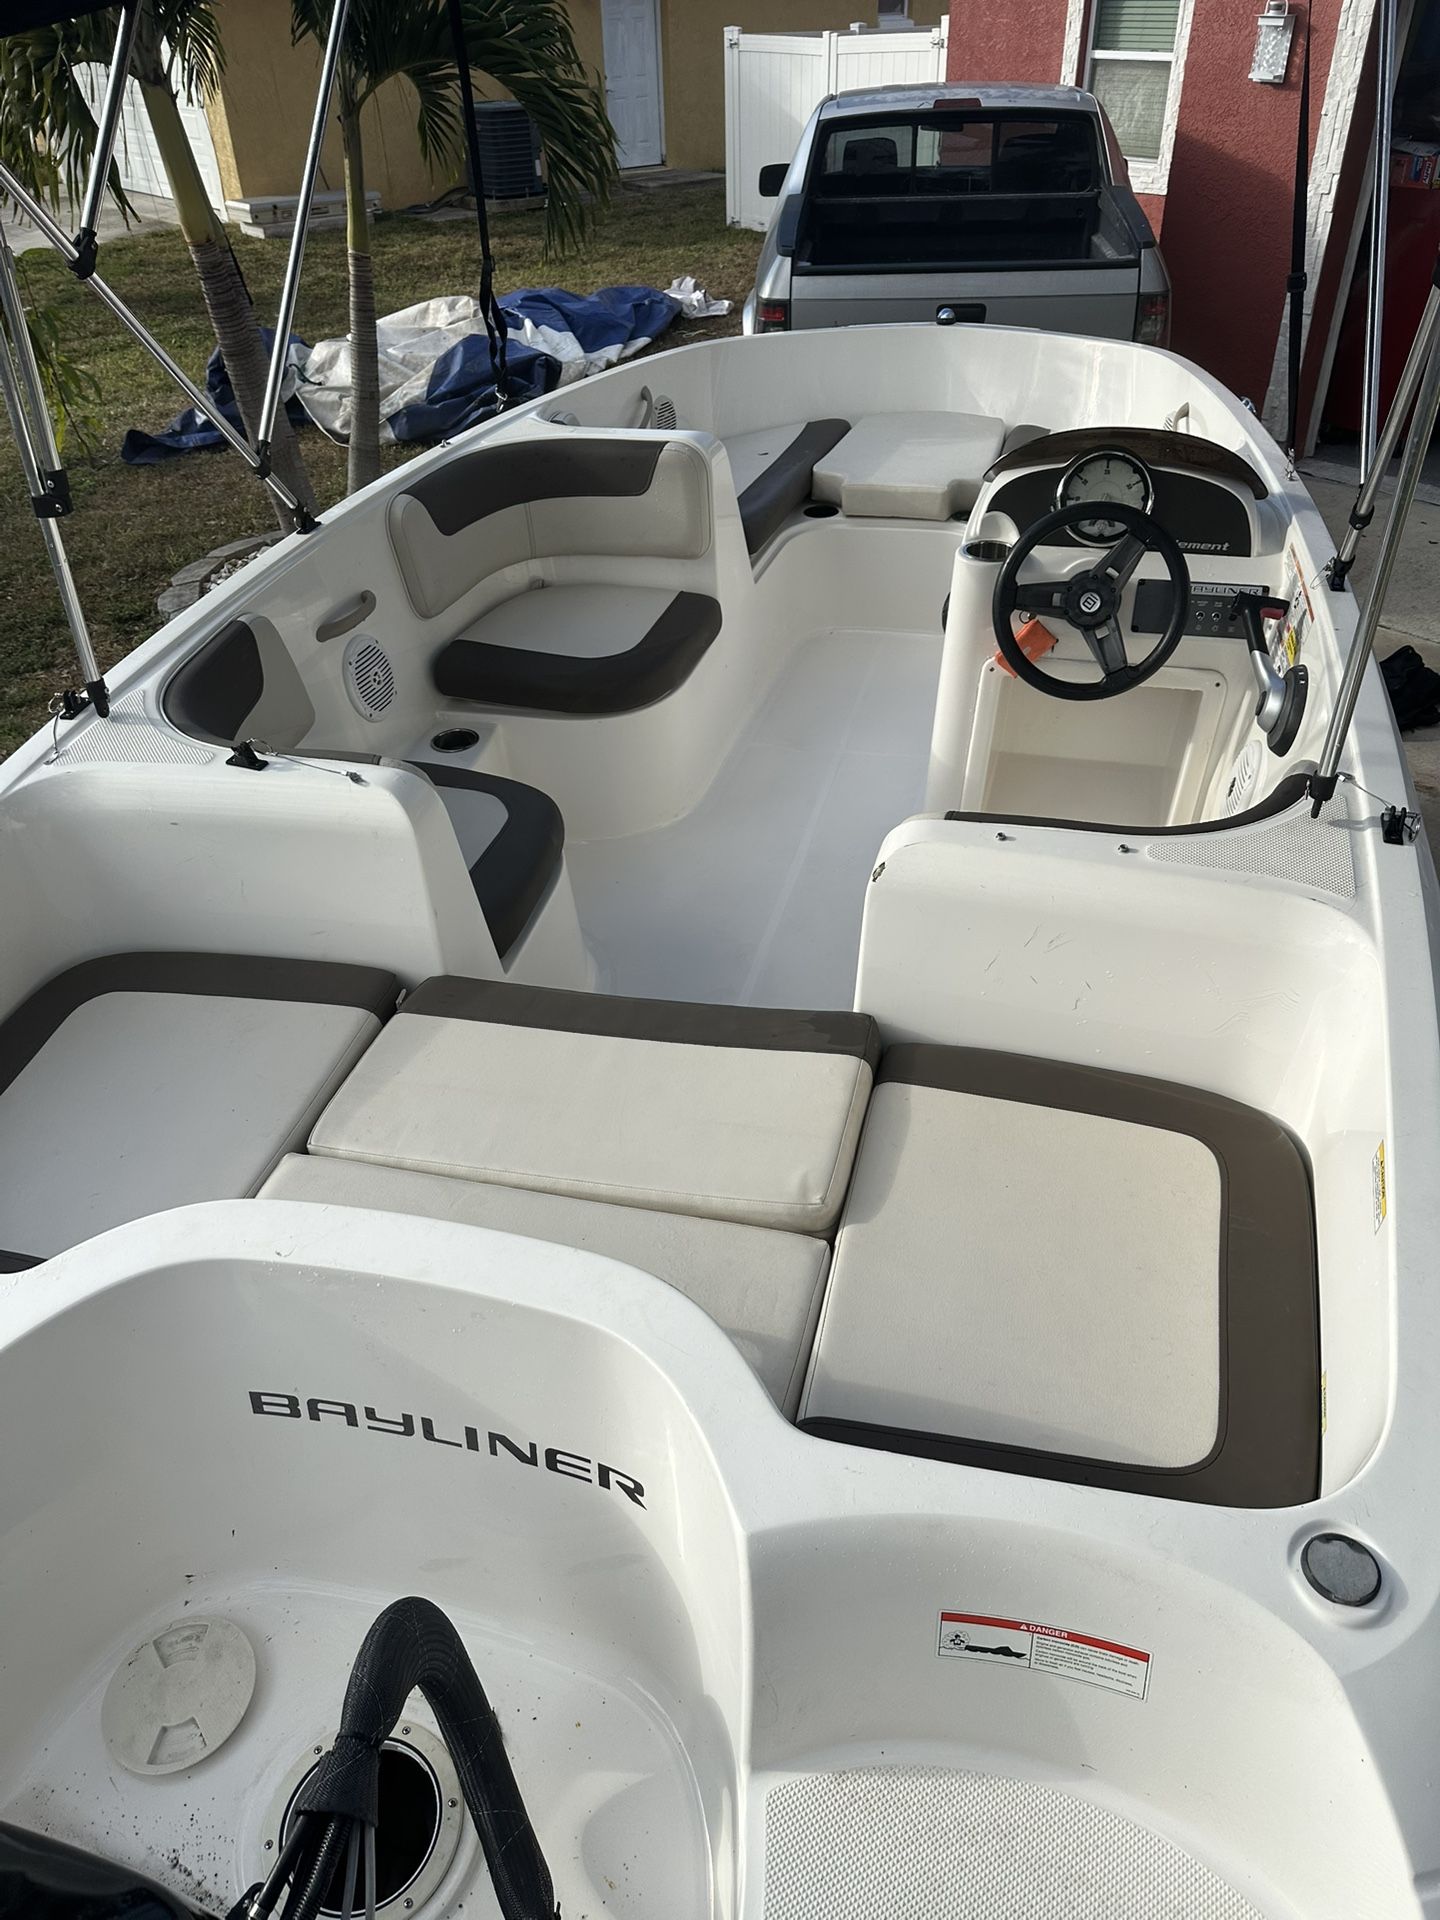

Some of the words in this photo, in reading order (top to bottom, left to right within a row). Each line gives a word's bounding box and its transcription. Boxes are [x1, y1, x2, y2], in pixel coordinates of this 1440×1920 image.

[1175, 539, 1230, 551] ement
[1190, 585, 1260, 597] AYLINR
[248, 1391, 648, 1511] BAYLINER
[1029, 1624, 1068, 1639] DANGER
